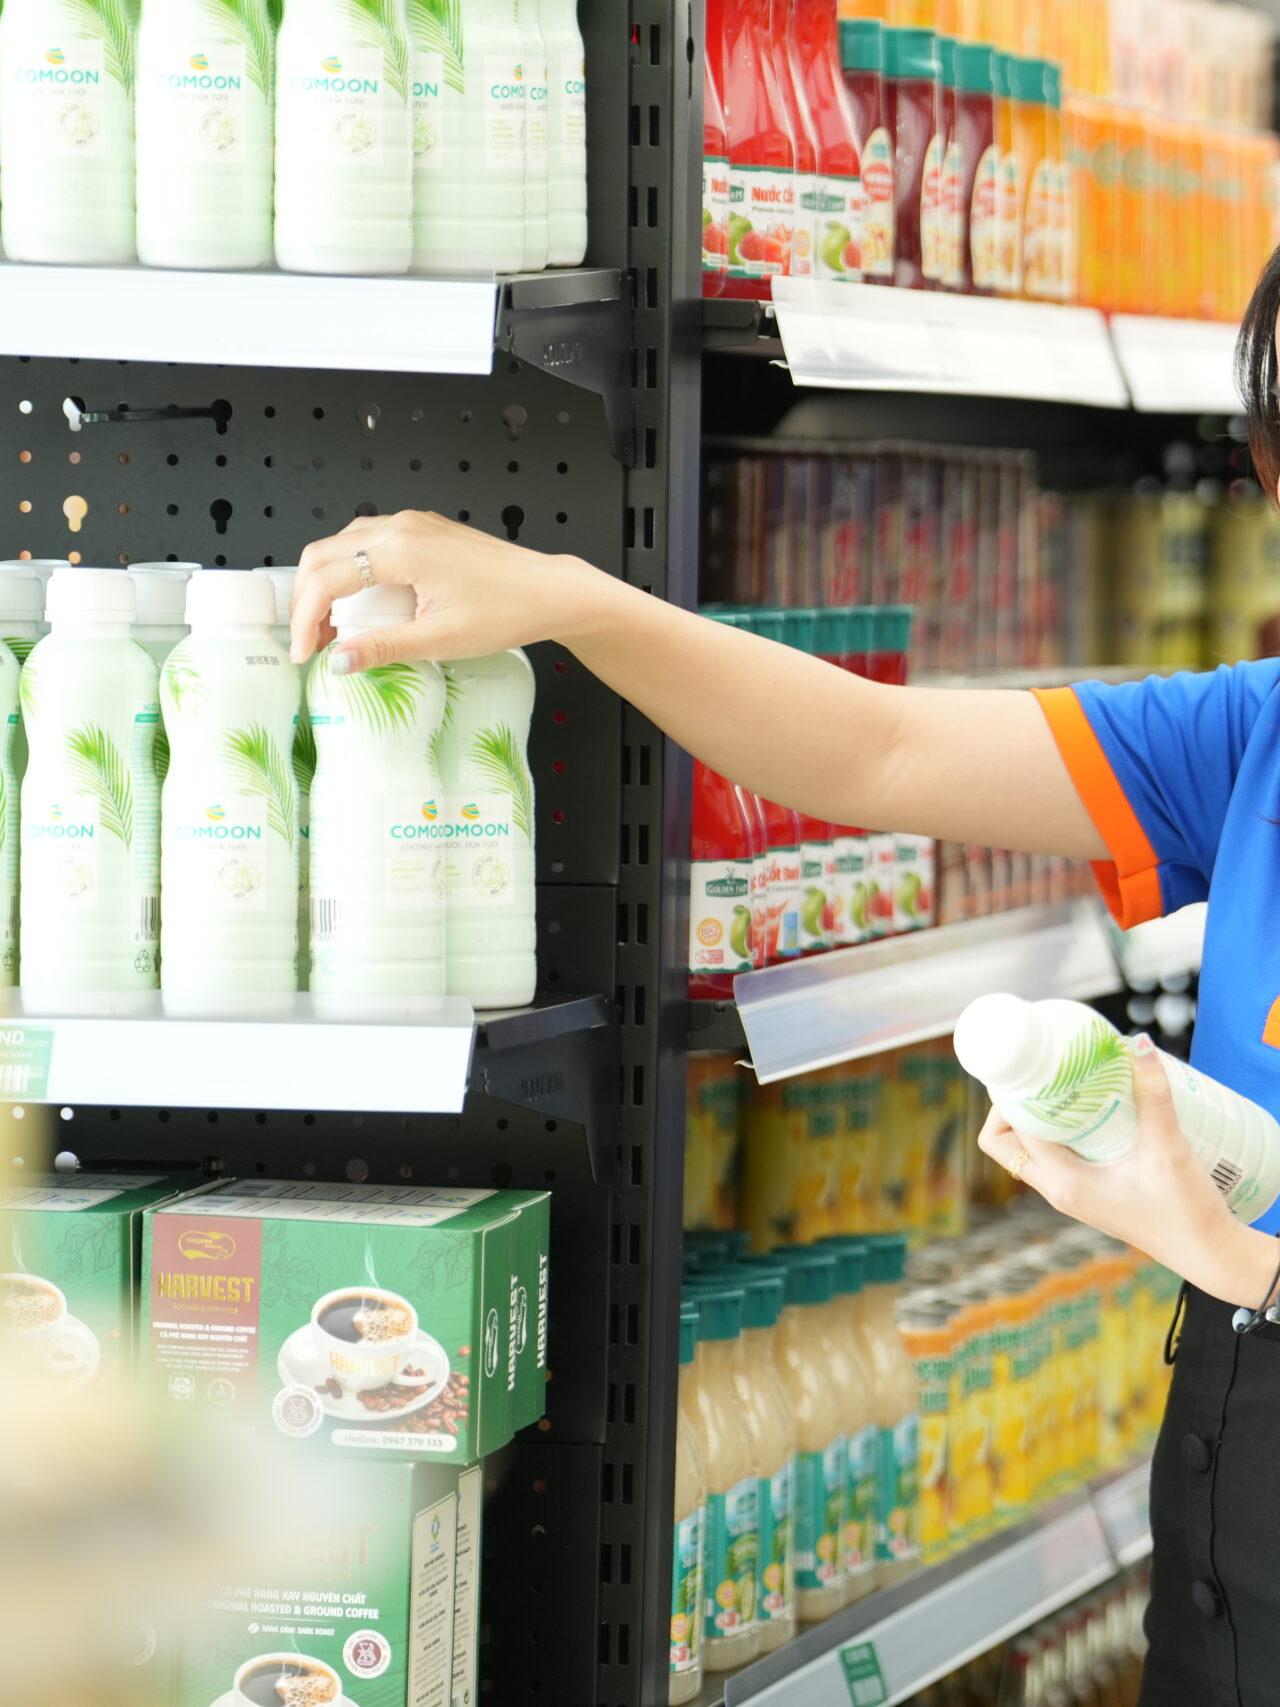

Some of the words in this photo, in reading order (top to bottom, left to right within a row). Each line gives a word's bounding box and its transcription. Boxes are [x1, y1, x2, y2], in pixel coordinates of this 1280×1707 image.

[16, 68, 100, 85] COMOON
[158, 74, 242, 90] COMOON
[290, 77, 379, 94] COMOON
[25, 824, 95, 839] COMOON
[175, 824, 262, 839] COMOON
[157, 1272, 255, 1303] HARVEST
[536, 1253, 547, 1369] HARVEST
[506, 1274, 518, 1391] HARVEST
[328, 1349, 401, 1377] HARVEST
[254, 1588, 280, 1600] RANG
[282, 1591, 300, 1602] XAY
[207, 1599, 249, 1612] ORIGINAL
[250, 1602, 292, 1615] ROASTED
[293, 1604, 301, 1616] &
[303, 1605, 343, 1618] GROUND
[345, 1607, 380, 1620] COFFEE
